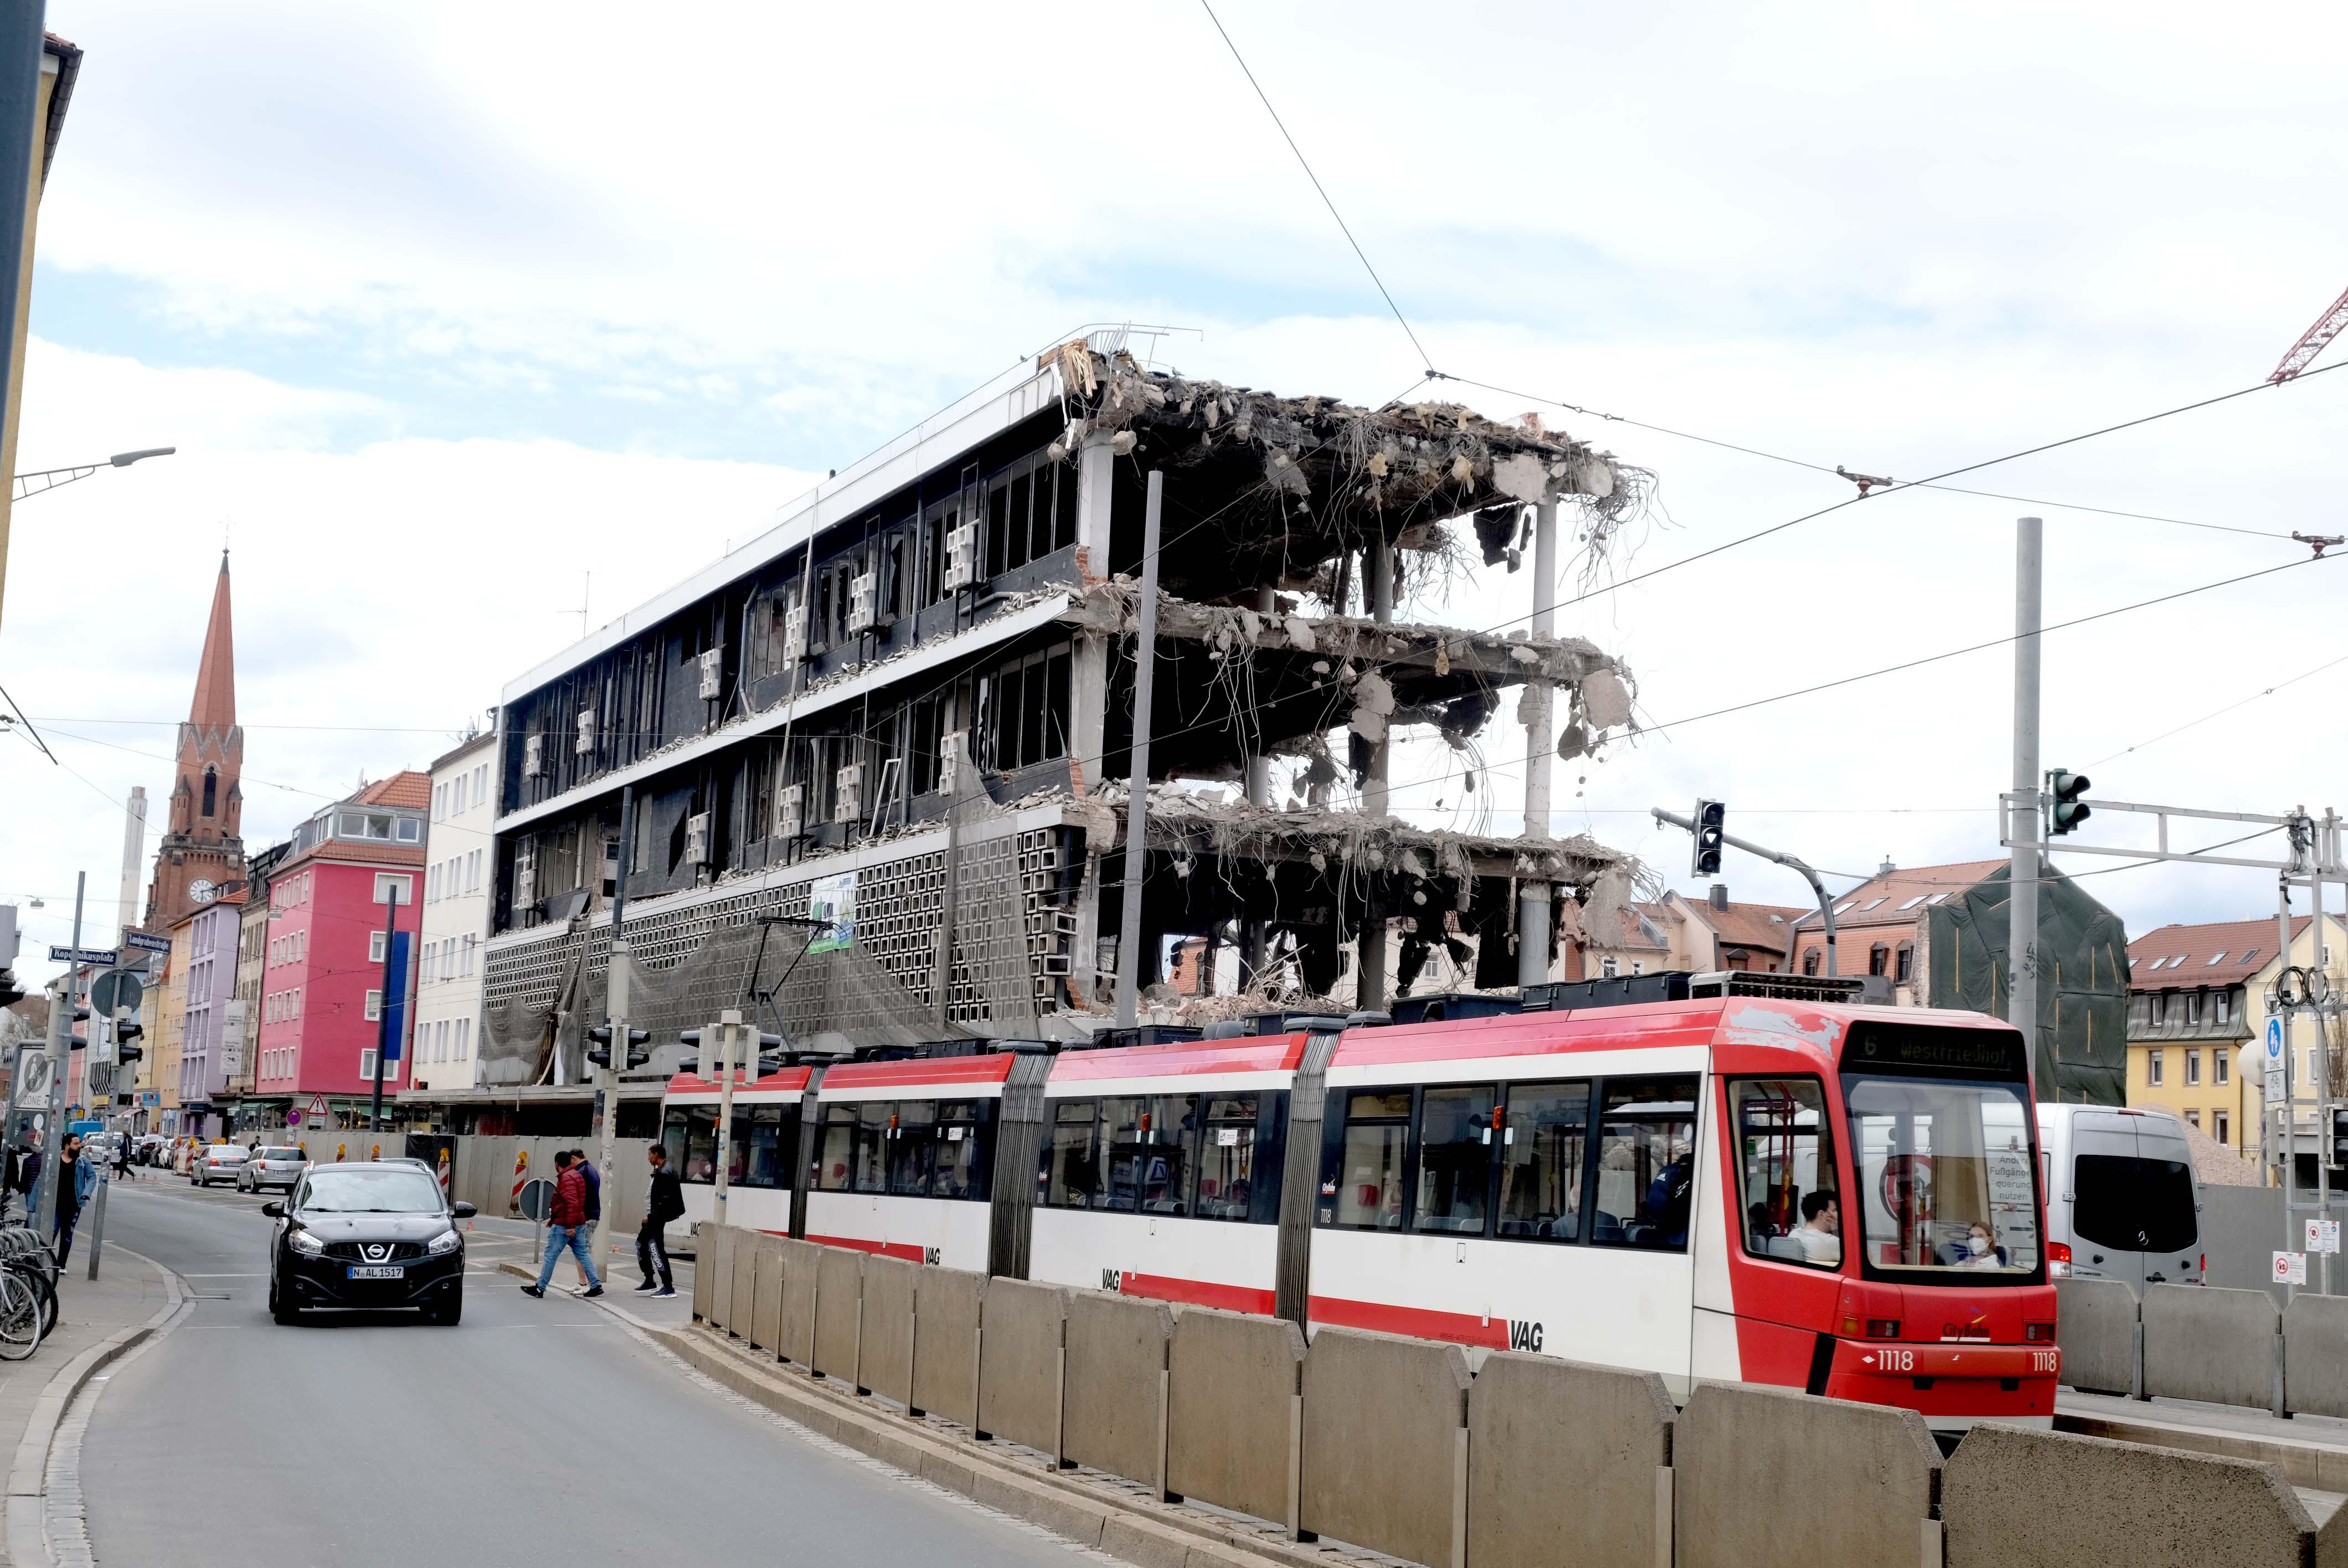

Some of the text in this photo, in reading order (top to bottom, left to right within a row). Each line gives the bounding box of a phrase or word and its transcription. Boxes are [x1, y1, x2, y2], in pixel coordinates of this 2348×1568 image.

[129, 936, 169, 951] Landgrabenstraße
[54, 948, 114, 962] Kopenikusplatz
[1865, 1034, 1878, 1055] 6
[23, 1095, 42, 1106] ZONE
[1999, 1156, 2030, 1164] Andere
[1999, 1192, 2027, 1200] nutzen
[1320, 1209, 1331, 1224] 1118
[650, 1242, 663, 1268] adidas
[925, 1246, 940, 1265] VAG
[354, 1268, 401, 1277] N AL 1517
[1102, 1268, 1120, 1291] VAG
[1511, 1319, 1543, 1353] VAG
[1942, 1322, 1990, 1342] CityBahn
[1878, 1349, 1914, 1371] 1118
[2033, 1352, 2057, 1372] 1118
